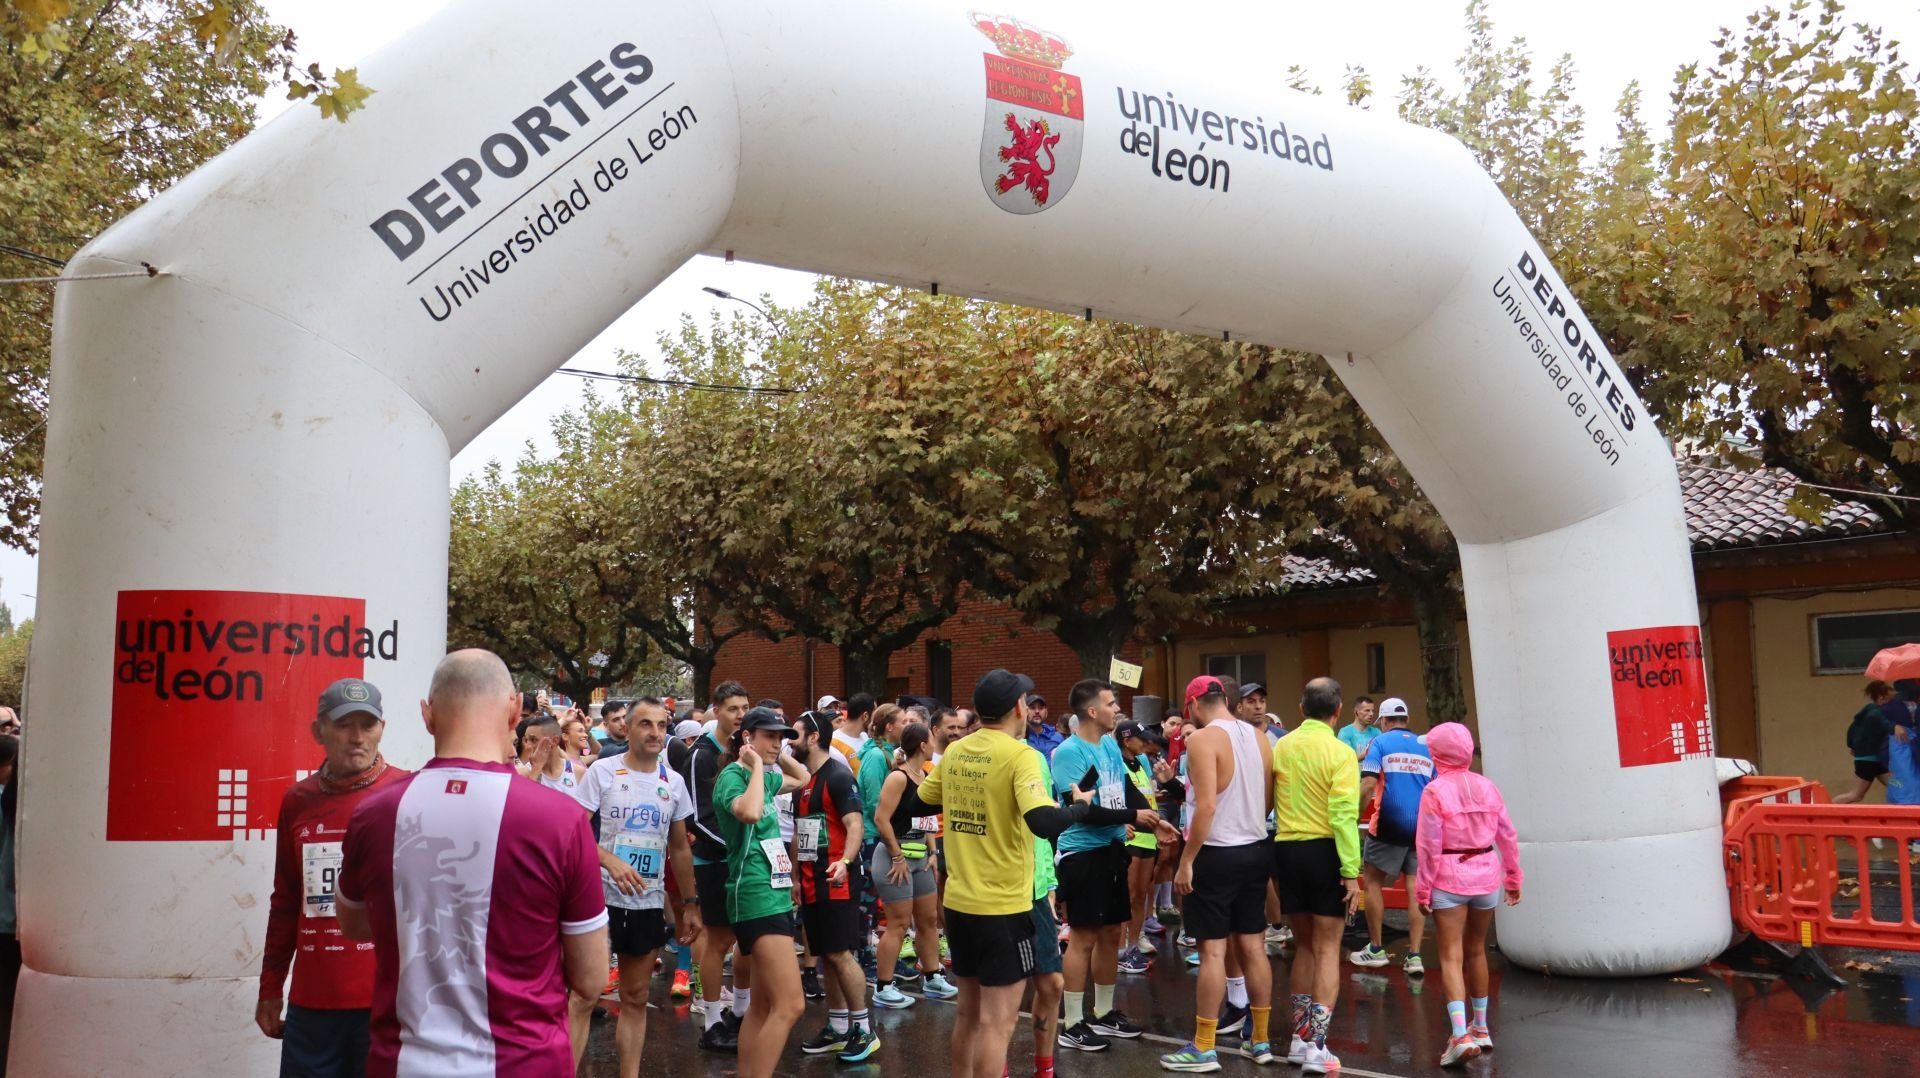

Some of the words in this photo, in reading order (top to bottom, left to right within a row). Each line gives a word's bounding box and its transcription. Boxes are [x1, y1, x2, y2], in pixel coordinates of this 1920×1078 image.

[369, 42, 654, 262] DEPORTES
[1116, 86, 1334, 171] universidad
[420, 178, 591, 322] Universidad
[593, 157, 629, 193] de
[627, 105, 698, 164] León
[1492, 275, 1572, 392] Universidad
[1567, 391, 1587, 418] de
[1584, 414, 1620, 467] León
[1517, 250, 1636, 431] DEPORTES
[118, 609, 398, 661] universidad
[961, 767, 987, 781] llegar
[629, 853, 652, 873] 719
